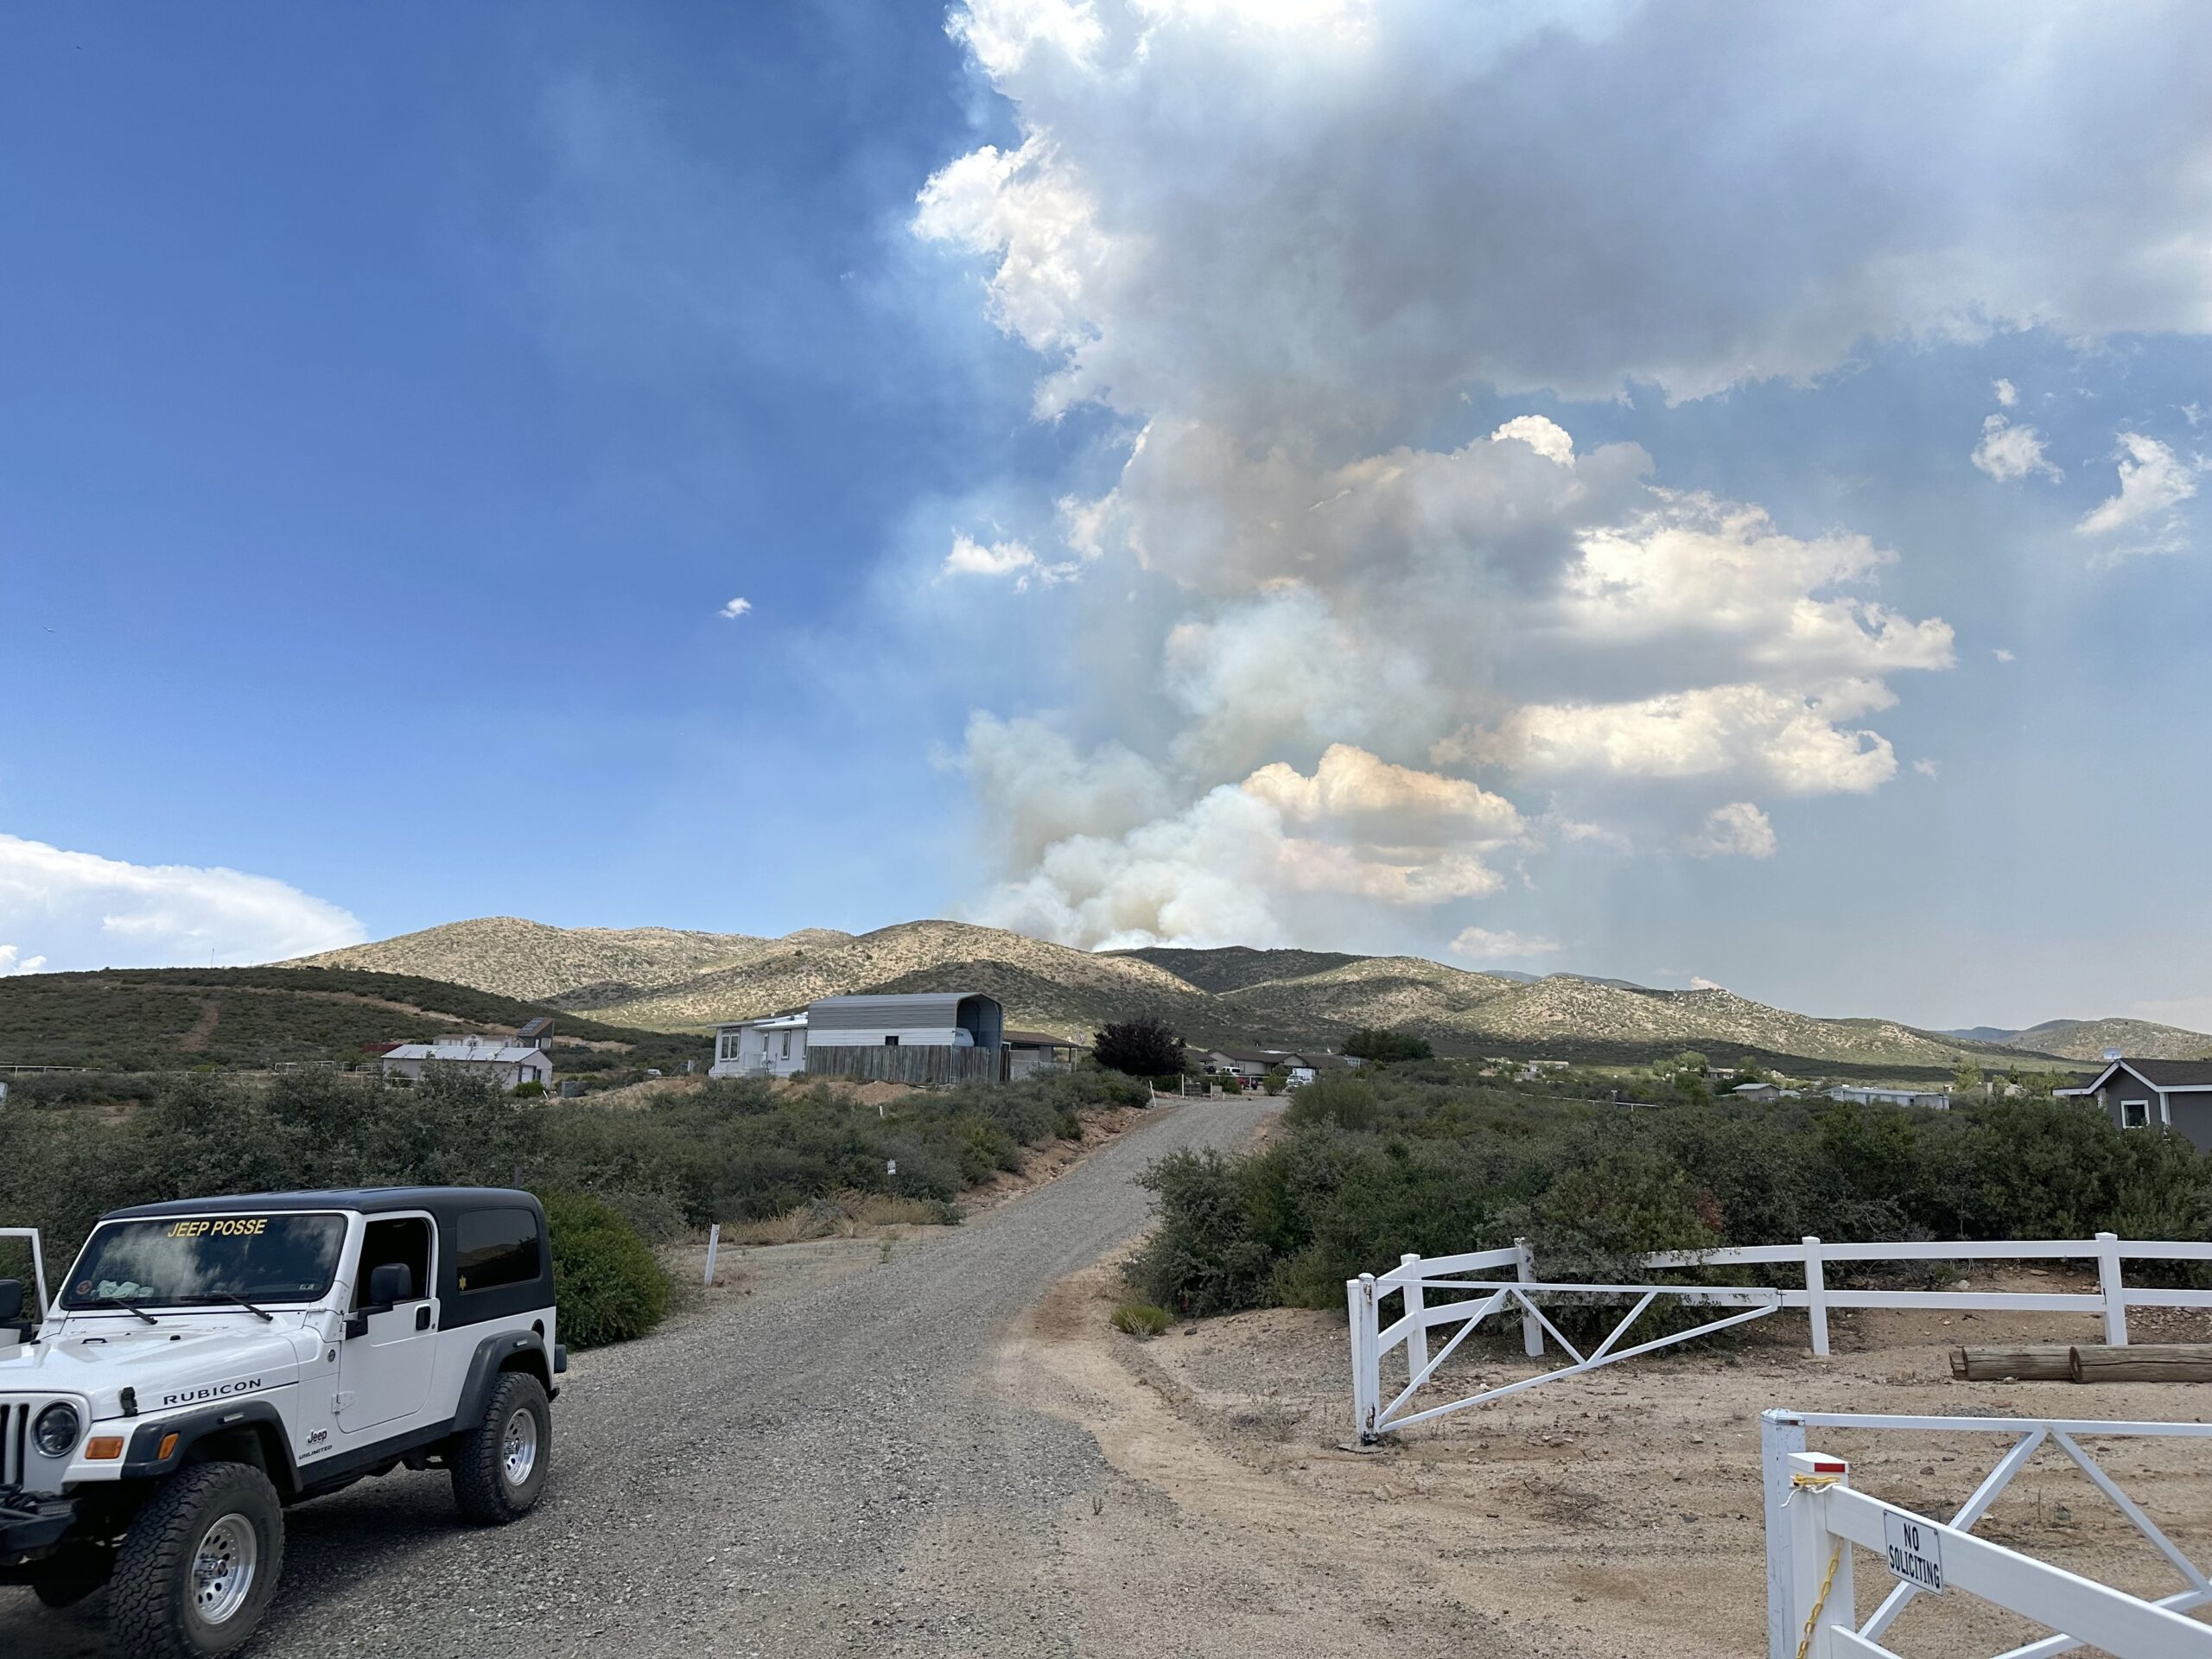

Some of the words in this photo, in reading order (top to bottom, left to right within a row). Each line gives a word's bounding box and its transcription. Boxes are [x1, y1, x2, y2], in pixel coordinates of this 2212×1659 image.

[167, 1221, 210, 1237] JEEP
[210, 1219, 268, 1236] POSSE
[163, 1378, 262, 1405] RUBICON
[307, 1429, 327, 1444] Jeep
[298, 1445, 333, 1460] UNLIMITED
[1904, 1522, 1920, 1552] NO
[1889, 1544, 1941, 1589] SOLICITING
